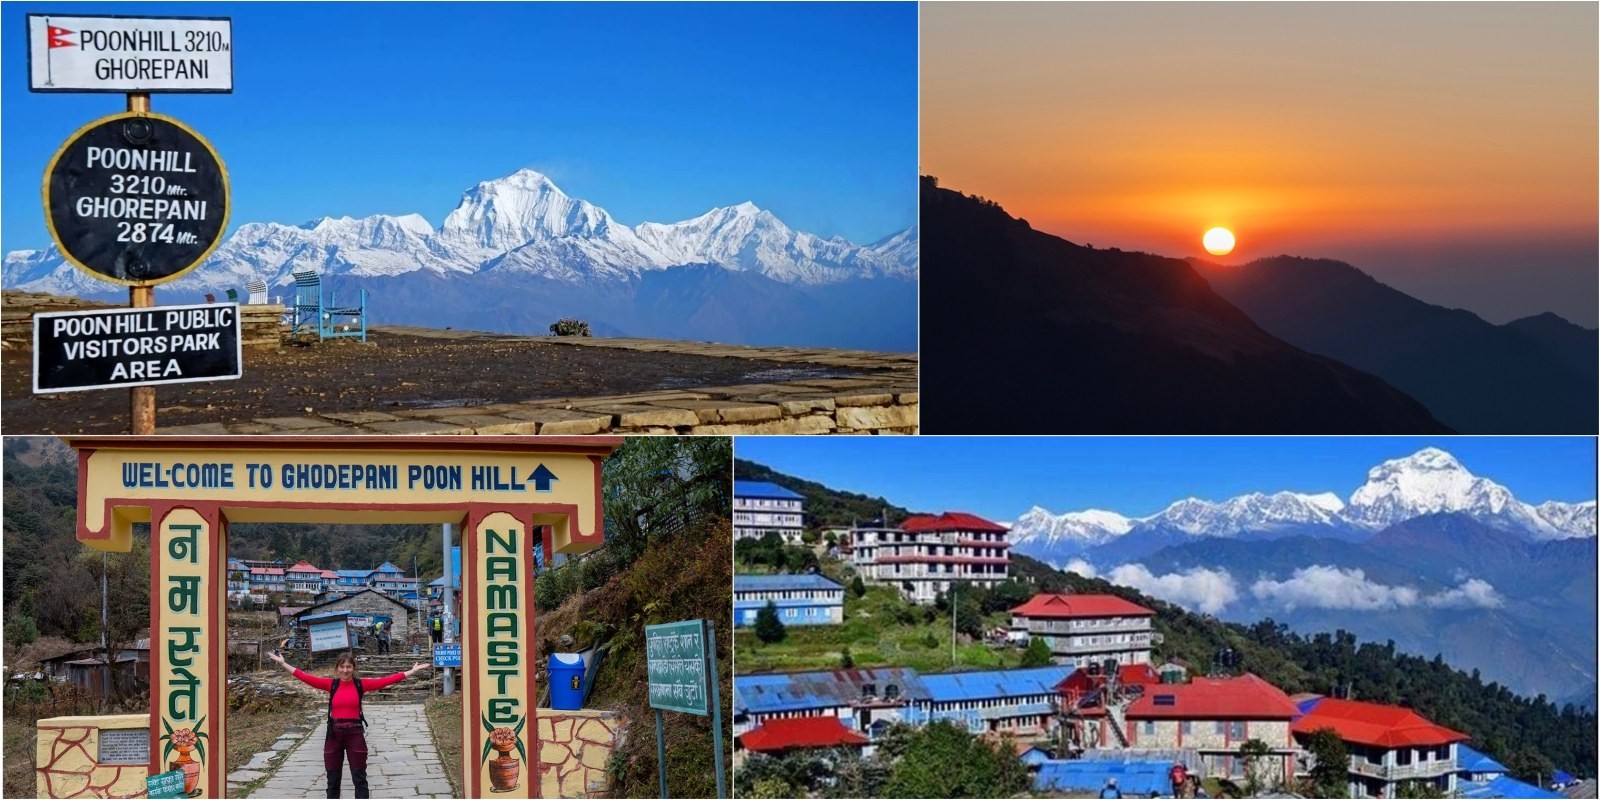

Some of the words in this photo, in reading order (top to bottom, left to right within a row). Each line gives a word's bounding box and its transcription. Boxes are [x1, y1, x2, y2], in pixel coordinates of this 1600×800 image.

[95, 58, 209, 79] GHOREPANI
[76, 196, 207, 220] GHOREPANI
[117, 222, 174, 243] 2874
[166, 308, 233, 331] PUBLIC
[63, 336, 168, 360] VISITORS
[171, 332, 220, 352] PARK
[110, 358, 182, 380] AREA
[245, 463, 273, 490] TO
[281, 463, 399, 490] GHODEPANI
[408, 465, 462, 491] POON
[471, 465, 527, 492] HILL
[485, 529, 520, 724] NAMASTE
